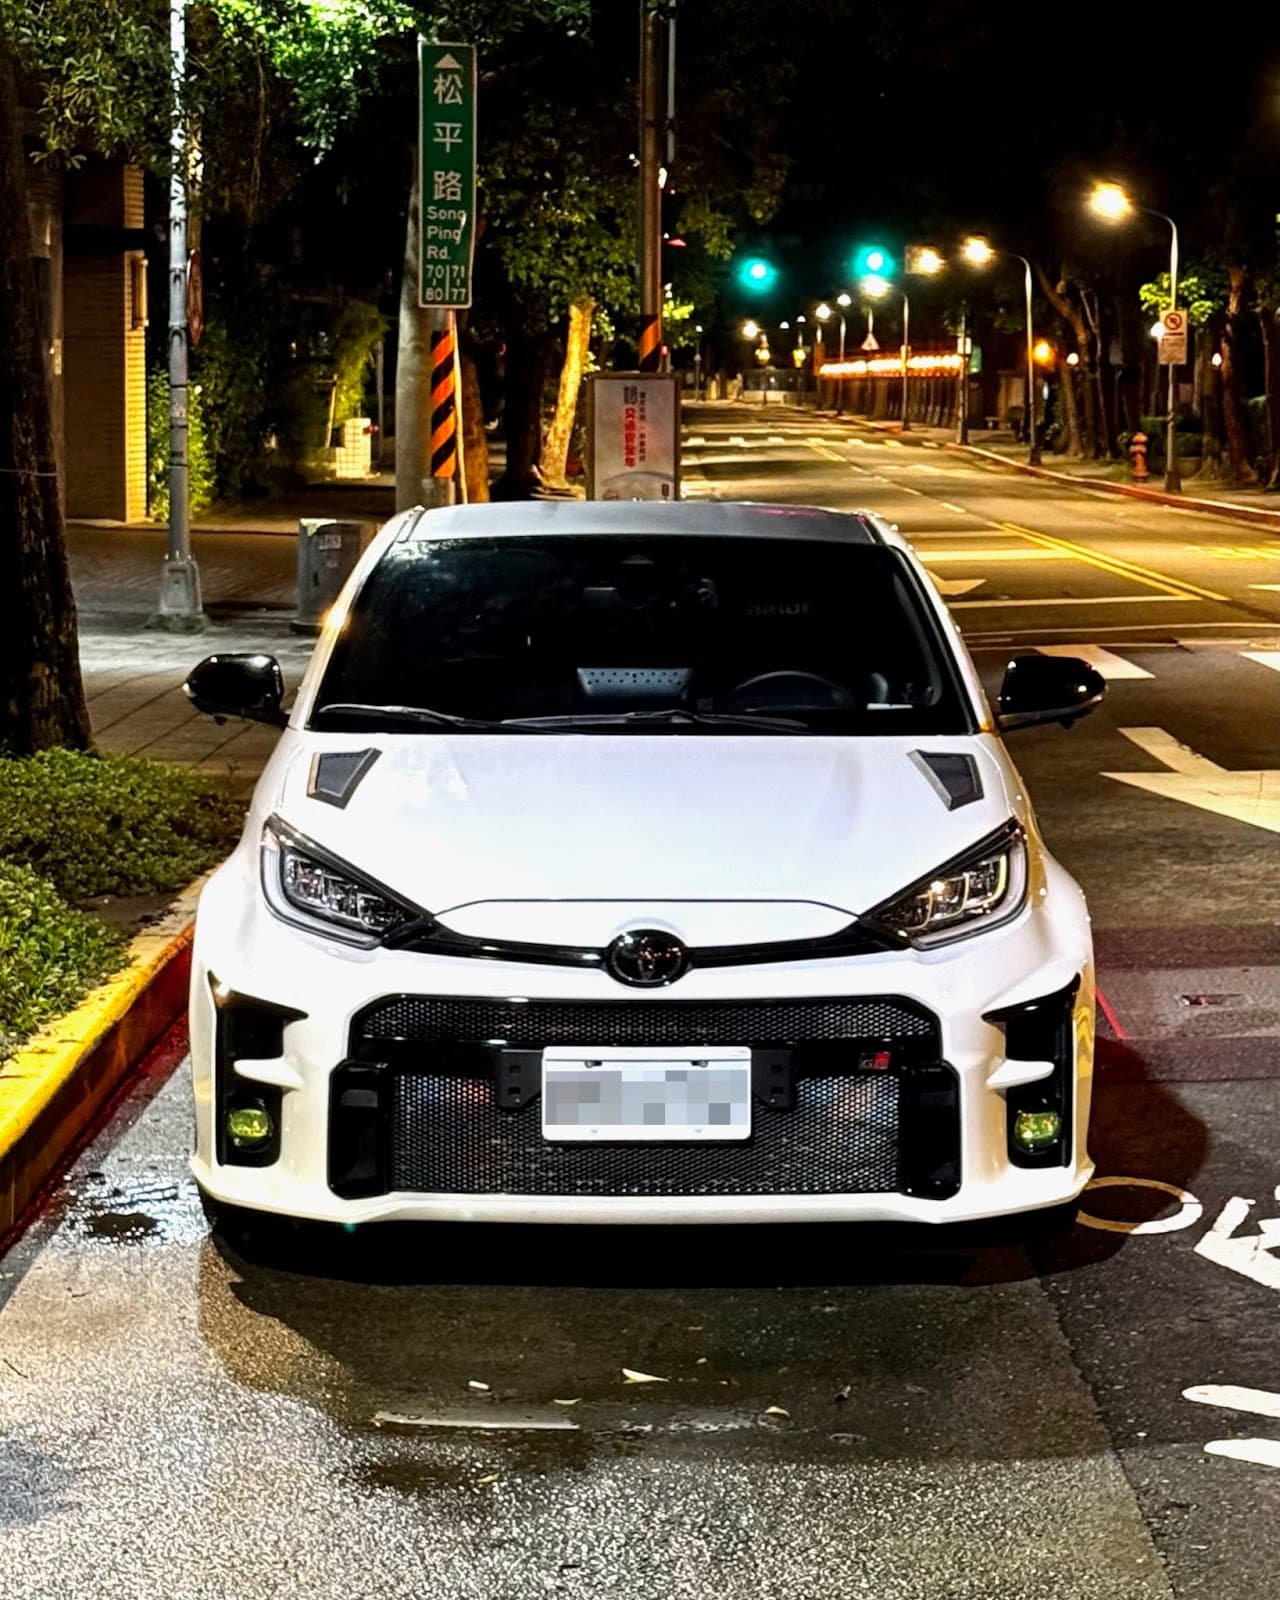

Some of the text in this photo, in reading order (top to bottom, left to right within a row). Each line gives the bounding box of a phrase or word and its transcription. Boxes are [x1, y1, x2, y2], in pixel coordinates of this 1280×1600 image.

[433, 73, 463, 201] 松平路
[427, 206, 466, 226] Song
[427, 225, 461, 244] Ping
[427, 245, 451, 260] Rd.
